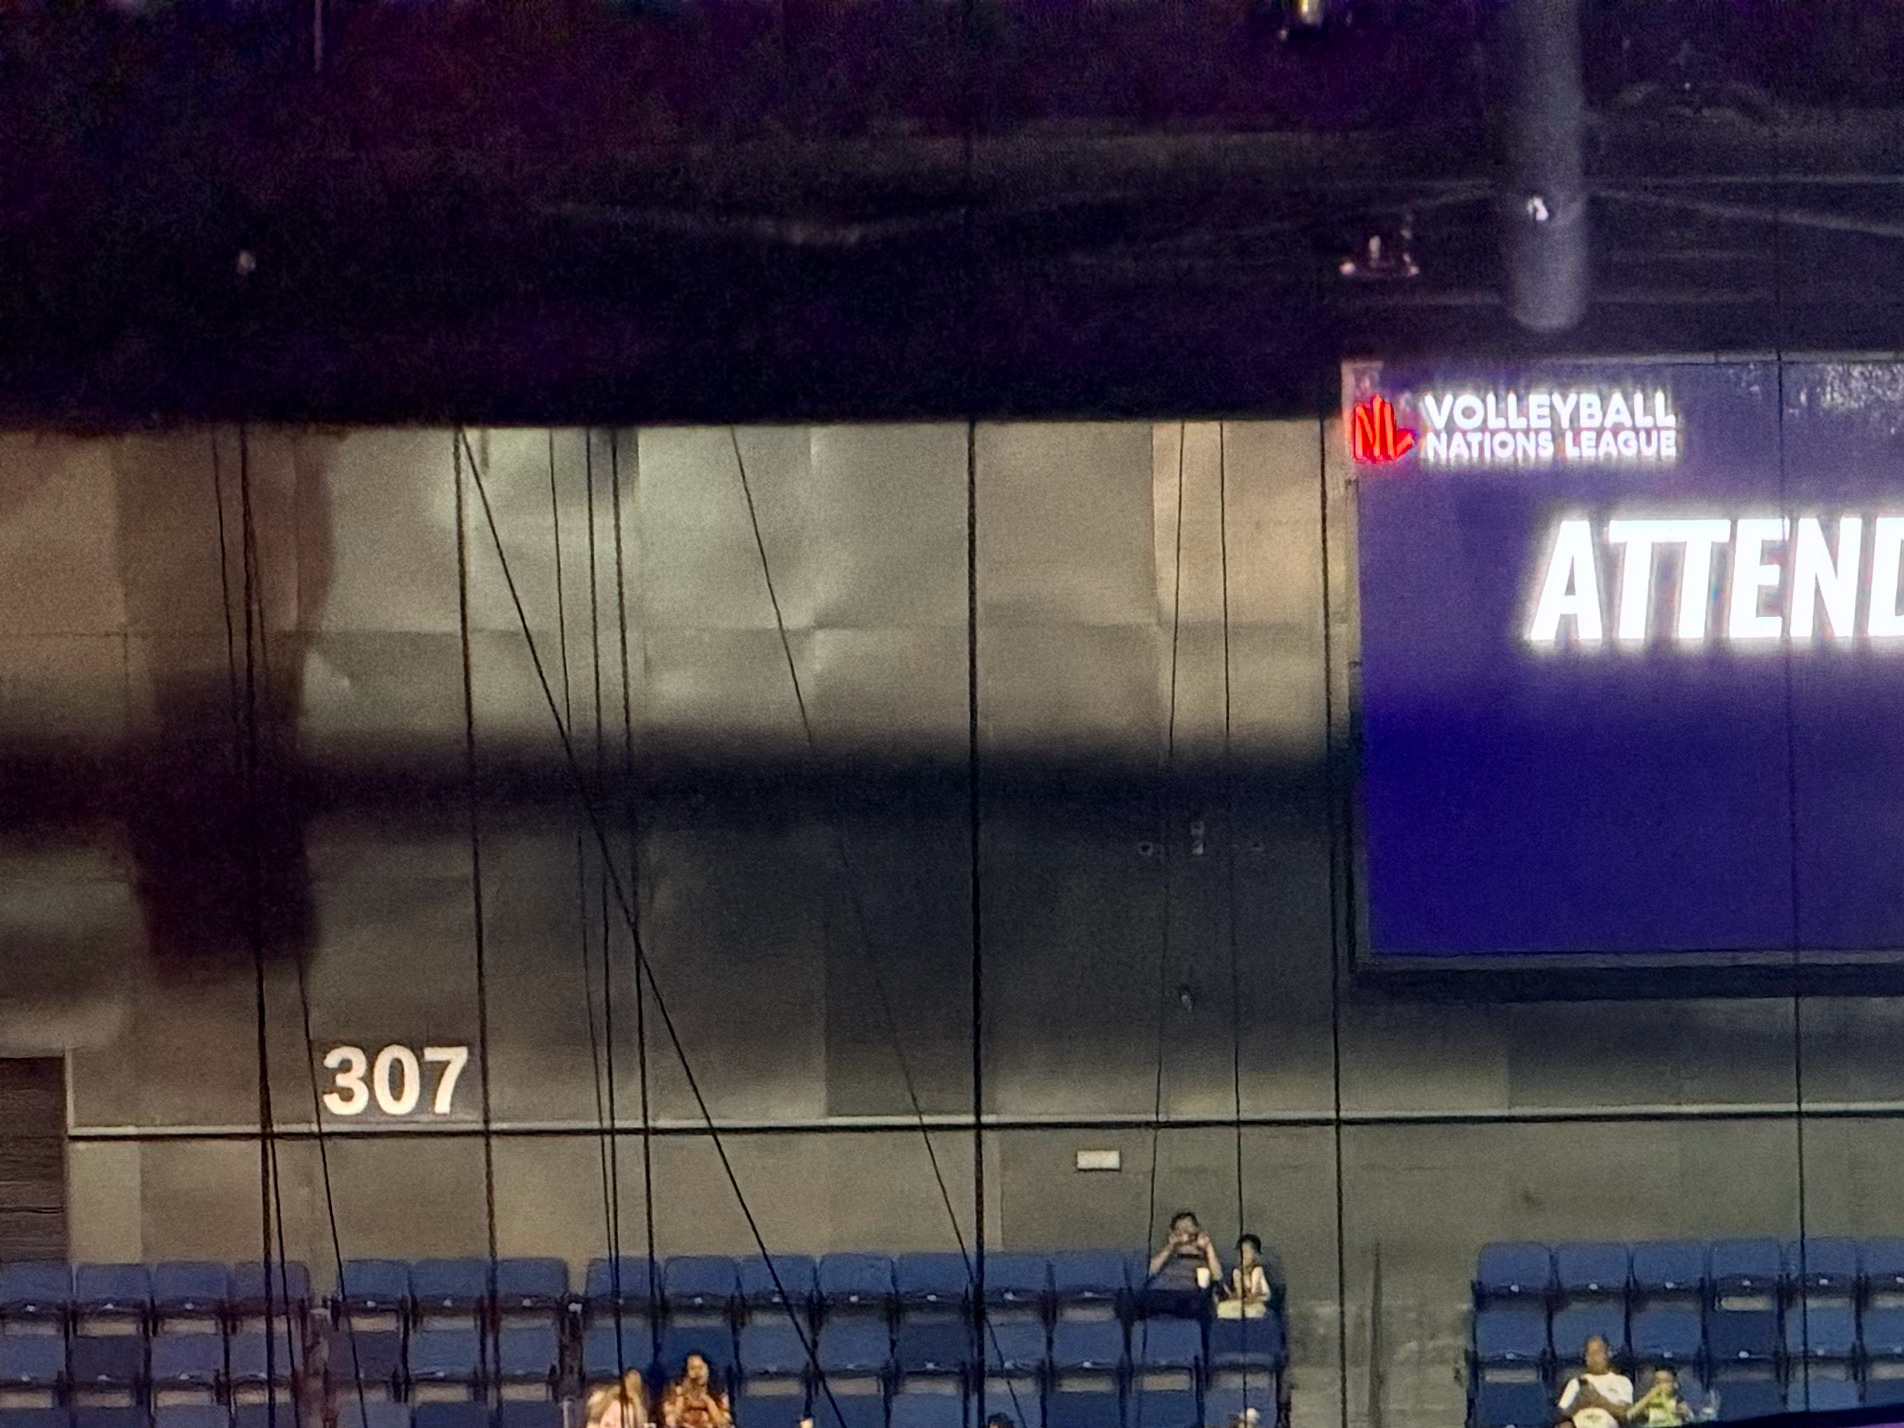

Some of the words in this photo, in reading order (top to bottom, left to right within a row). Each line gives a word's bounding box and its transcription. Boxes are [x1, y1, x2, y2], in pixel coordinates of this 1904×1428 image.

[1424, 390, 1677, 430] VOLLEYBALL
[1426, 430, 1555, 458] NATIONS
[1565, 430, 1677, 457] LEAGUE
[322, 1045, 468, 1115] 307
